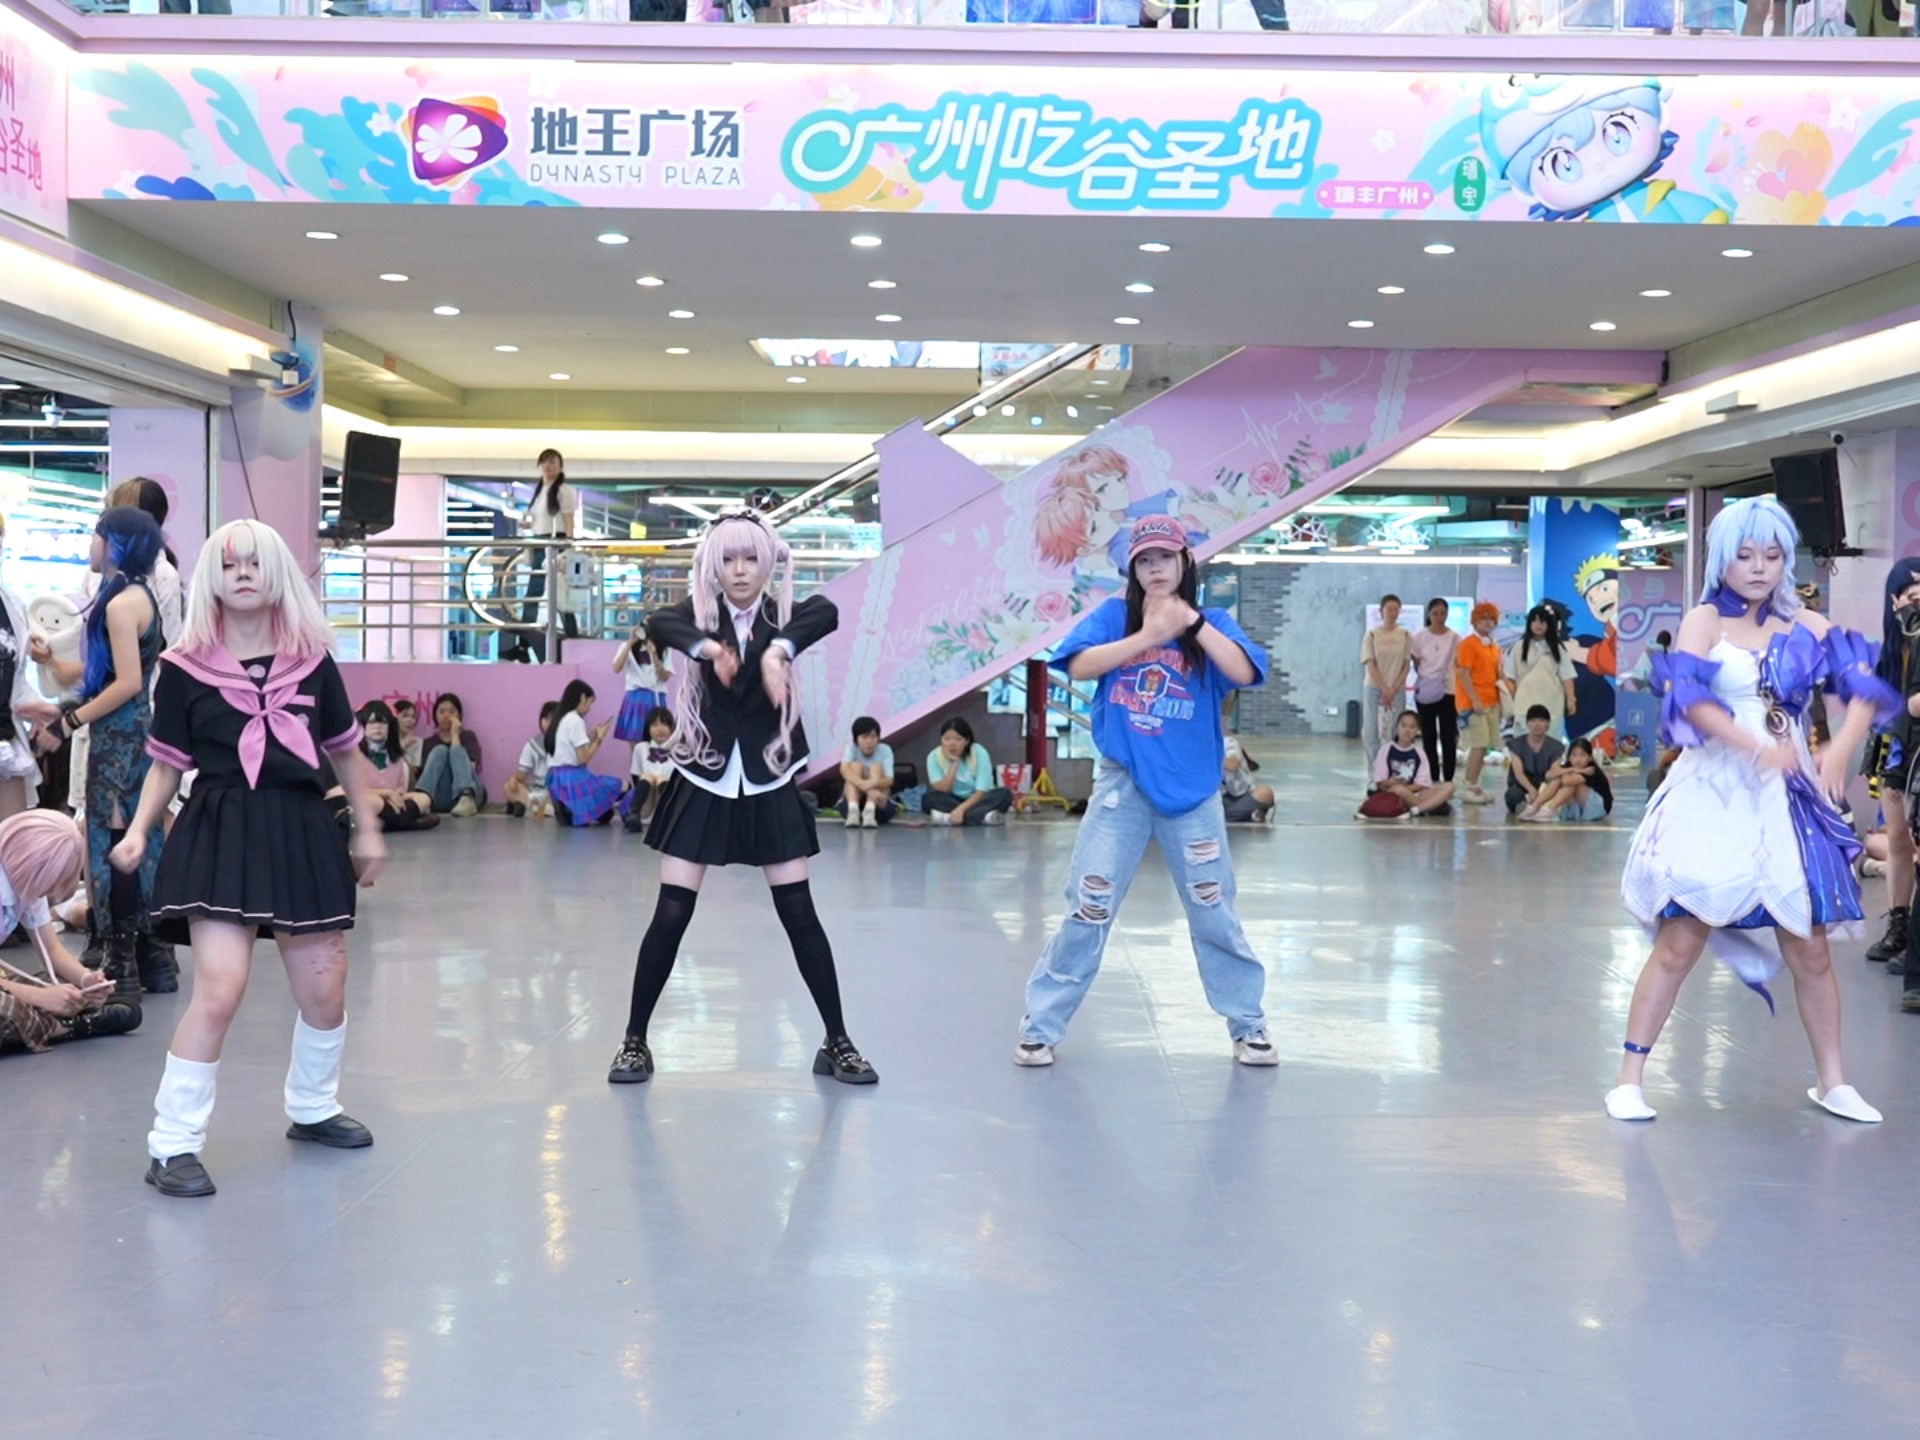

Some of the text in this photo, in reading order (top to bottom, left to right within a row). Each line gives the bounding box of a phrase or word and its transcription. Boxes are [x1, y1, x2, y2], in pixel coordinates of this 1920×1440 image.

[530, 106, 740, 158] 地王广场
[790, 101, 1312, 199] 广州吃谷圣地
[530, 163, 741, 186] DYNASTY PLAZA
[1333, 185, 1419, 205] 瑞丰广州
[1461, 158, 1479, 206] 瑞宝
